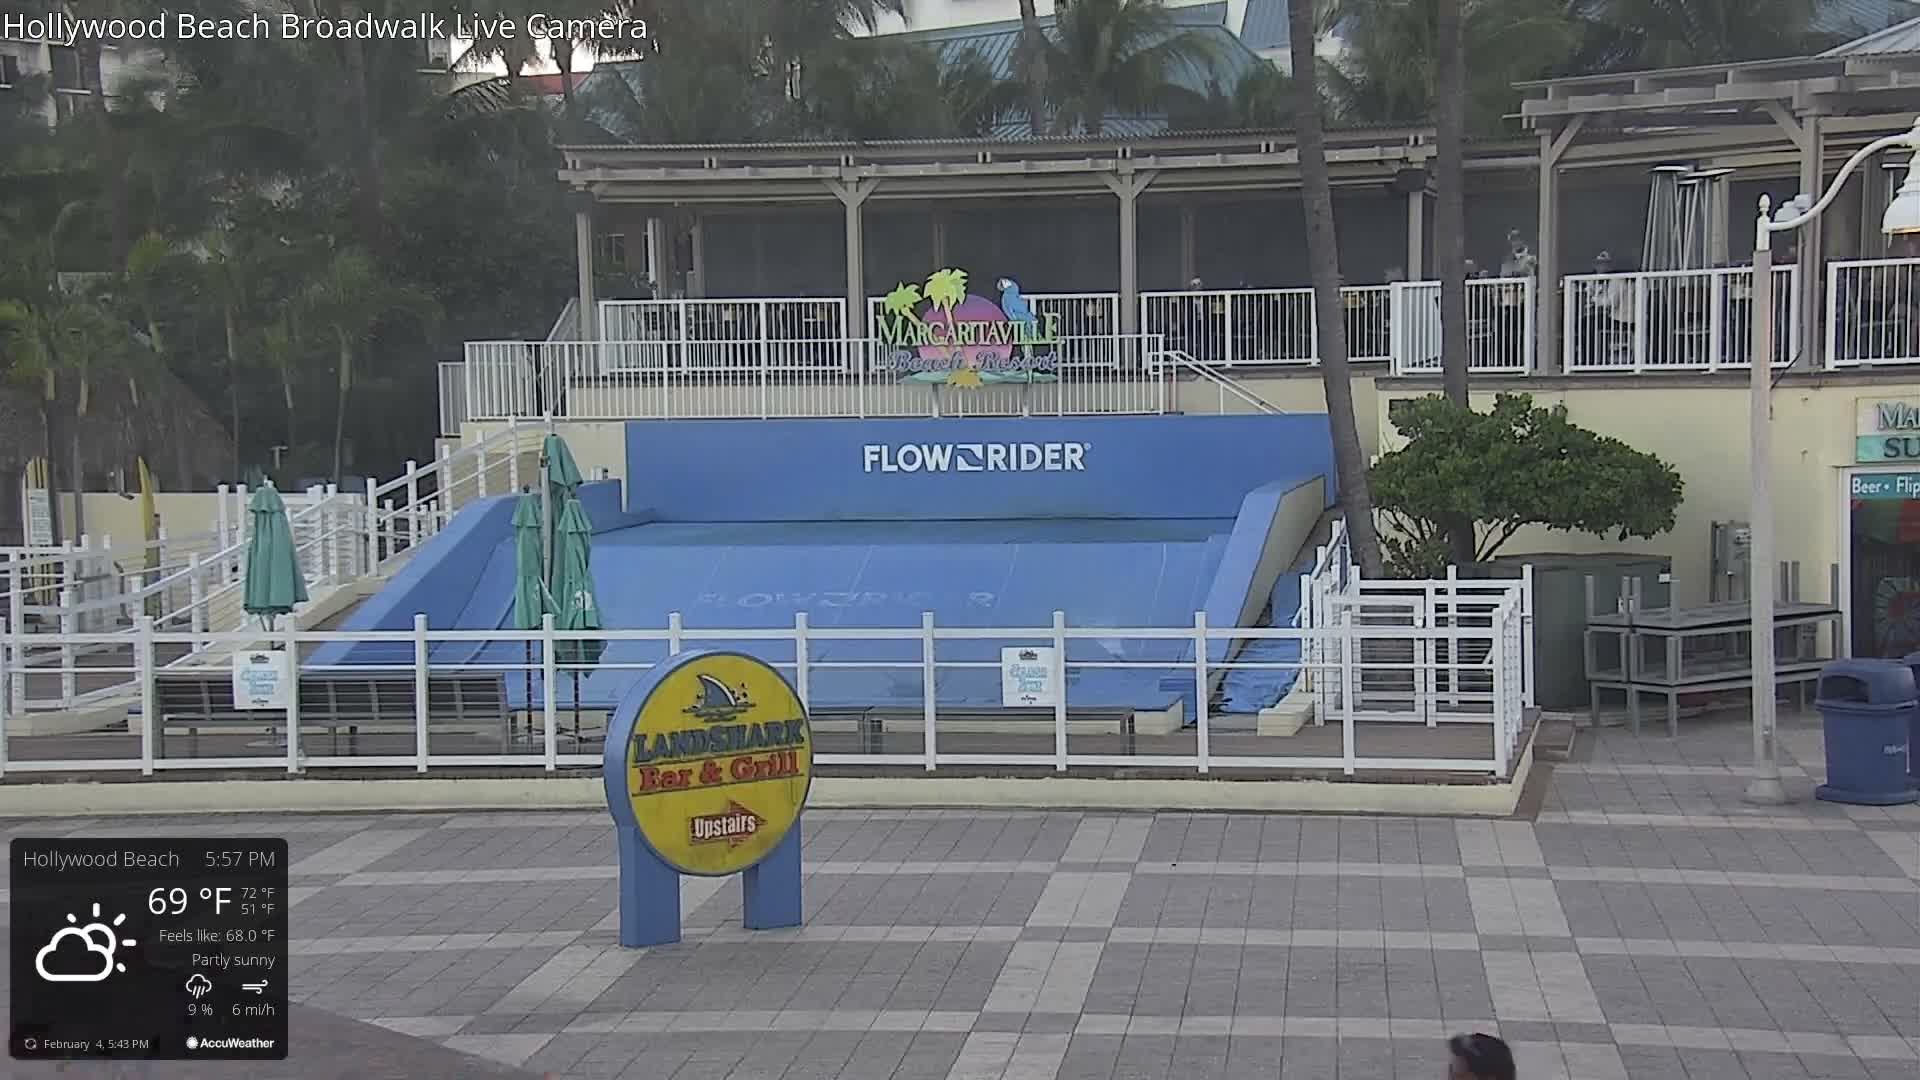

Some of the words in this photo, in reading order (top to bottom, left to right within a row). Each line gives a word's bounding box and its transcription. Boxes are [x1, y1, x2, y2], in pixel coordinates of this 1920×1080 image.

[888, 350, 965, 371] Beach
[976, 349, 1057, 371] Resort
[1851, 477, 1881, 493] Beer
[632, 718, 805, 763] LANDSHARK
[639, 761, 692, 792] Bar
[700, 758, 723, 785] &
[730, 751, 799, 779] Grill
[694, 813, 757, 839] Upstairs
